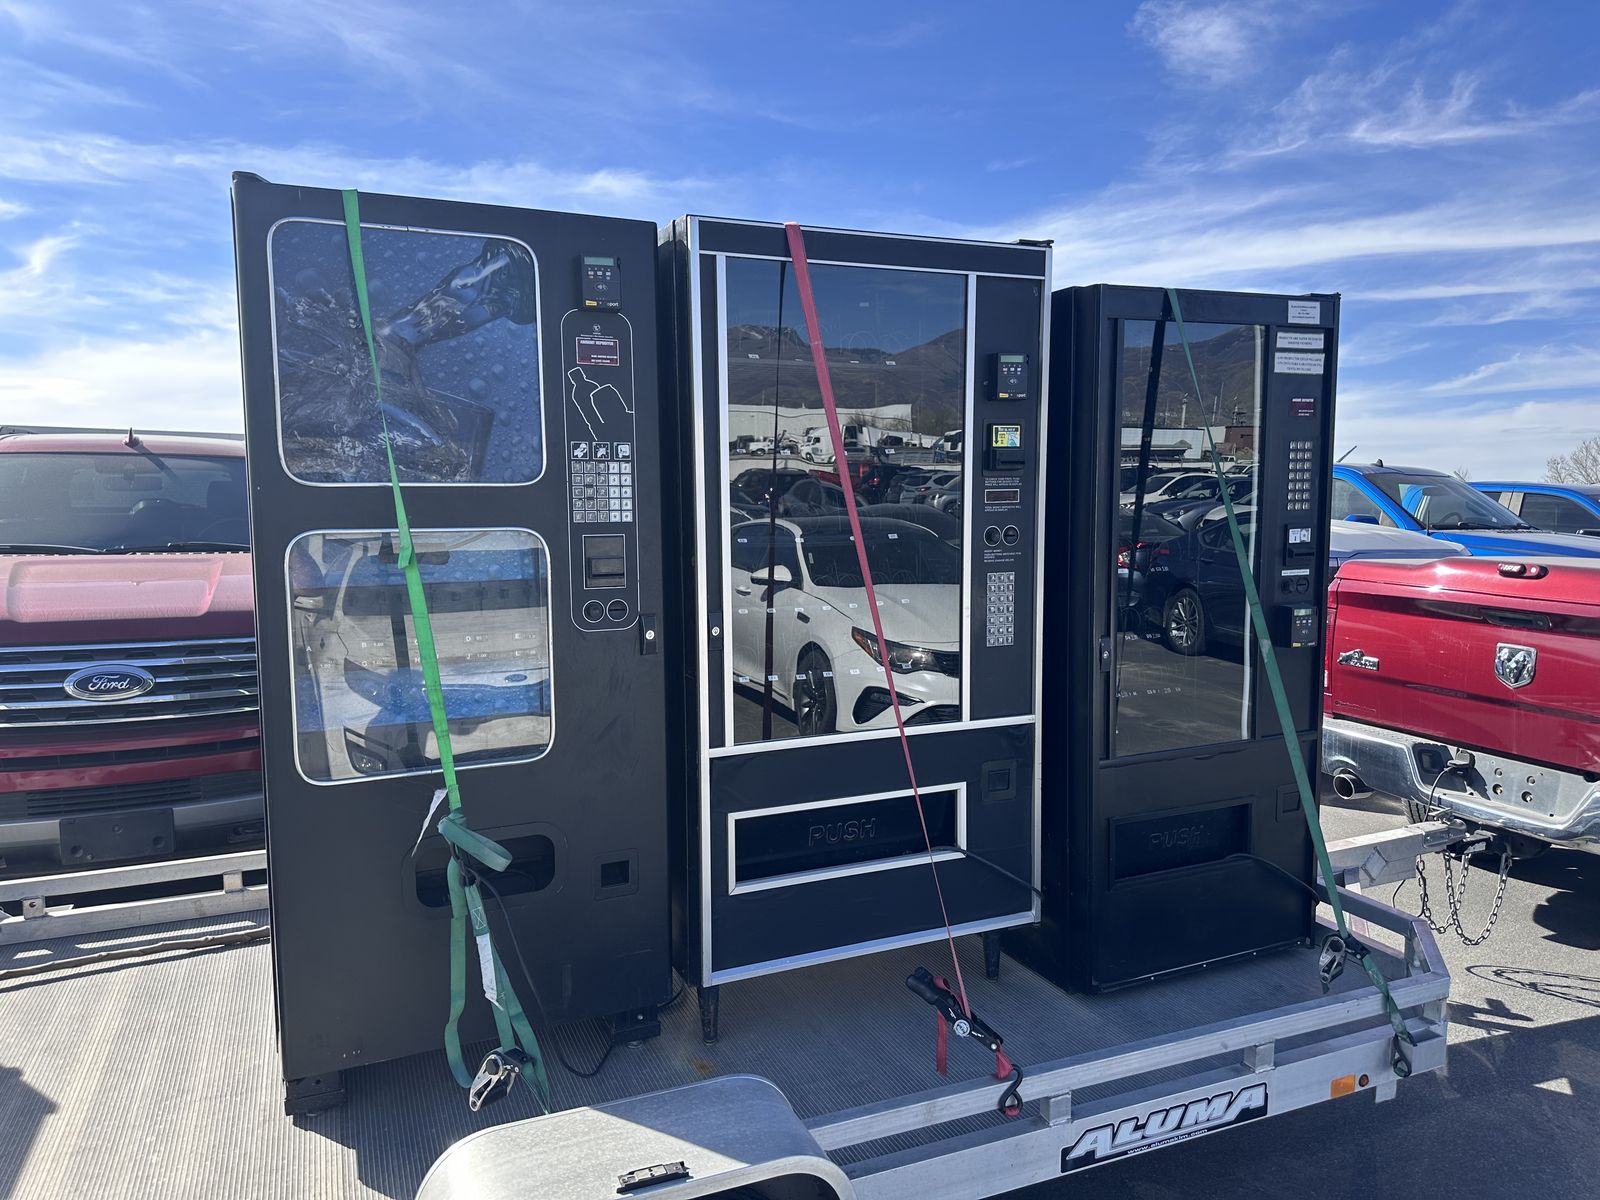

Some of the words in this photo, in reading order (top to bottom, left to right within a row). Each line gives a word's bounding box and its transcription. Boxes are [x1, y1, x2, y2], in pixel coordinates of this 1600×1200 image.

[88, 675, 130, 691] Ford
[808, 818, 876, 847] PUSH
[1150, 824, 1205, 849] PUSH
[1067, 1086, 1266, 1160] ALUMA
[1127, 1129, 1208, 1154] www.alumaklm.com
